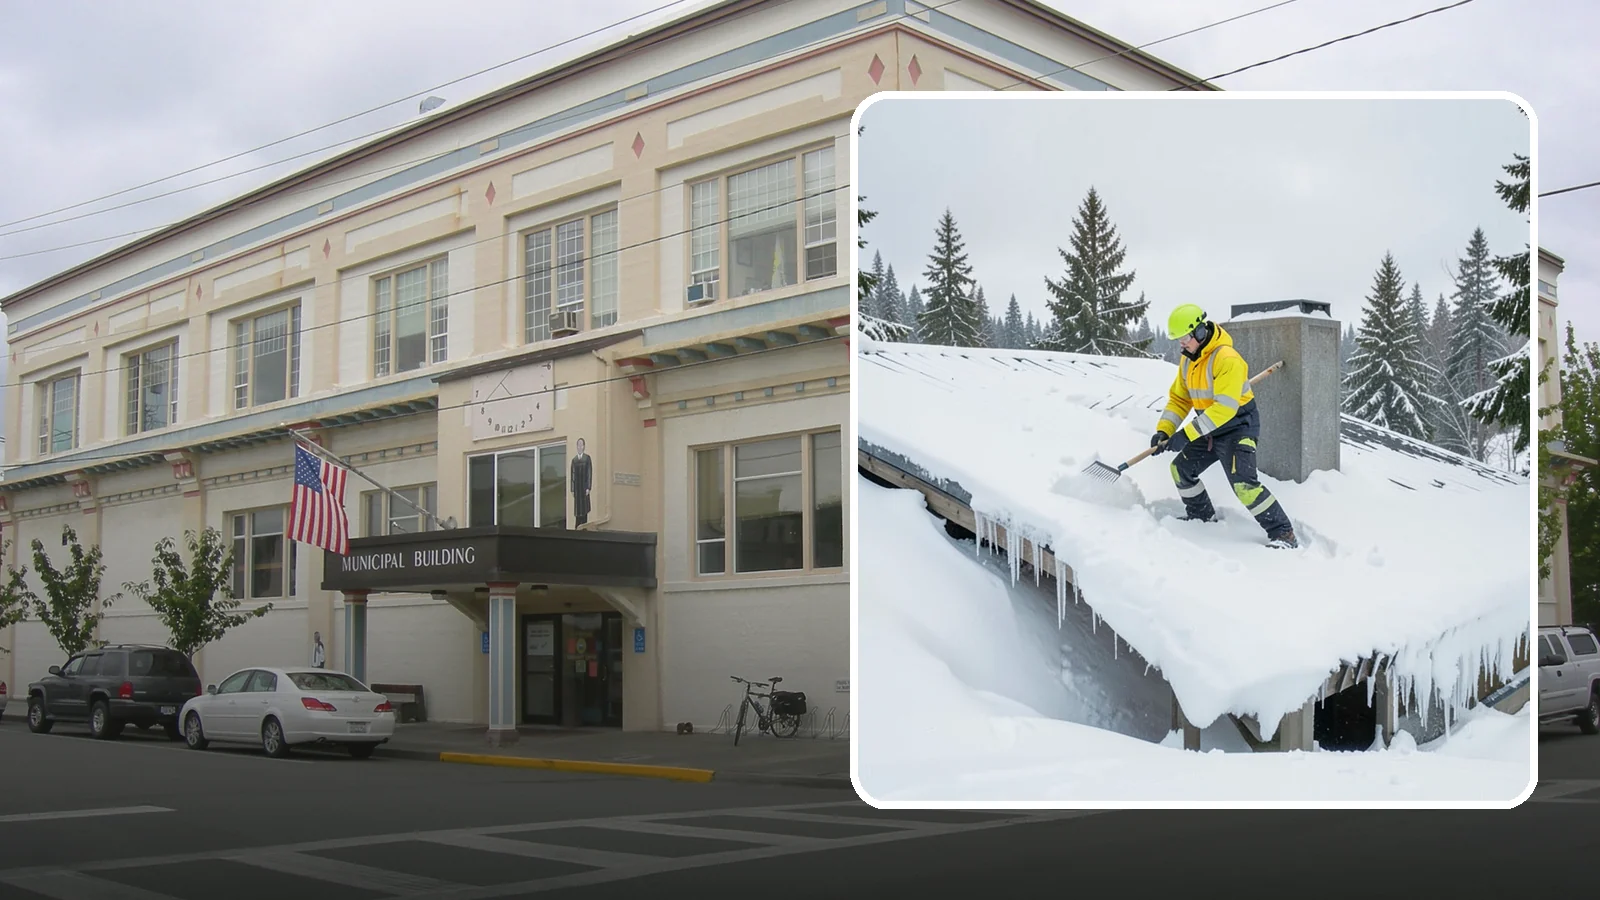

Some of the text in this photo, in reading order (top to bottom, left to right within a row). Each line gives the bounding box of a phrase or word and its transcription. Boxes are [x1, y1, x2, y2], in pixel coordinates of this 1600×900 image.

[480, 406, 485, 415] 8
[535, 402, 540, 410] 4
[487, 417, 492, 426] 9
[520, 420, 526, 428] 2
[342, 546, 475, 572] MUNICIPAL BUILDING
